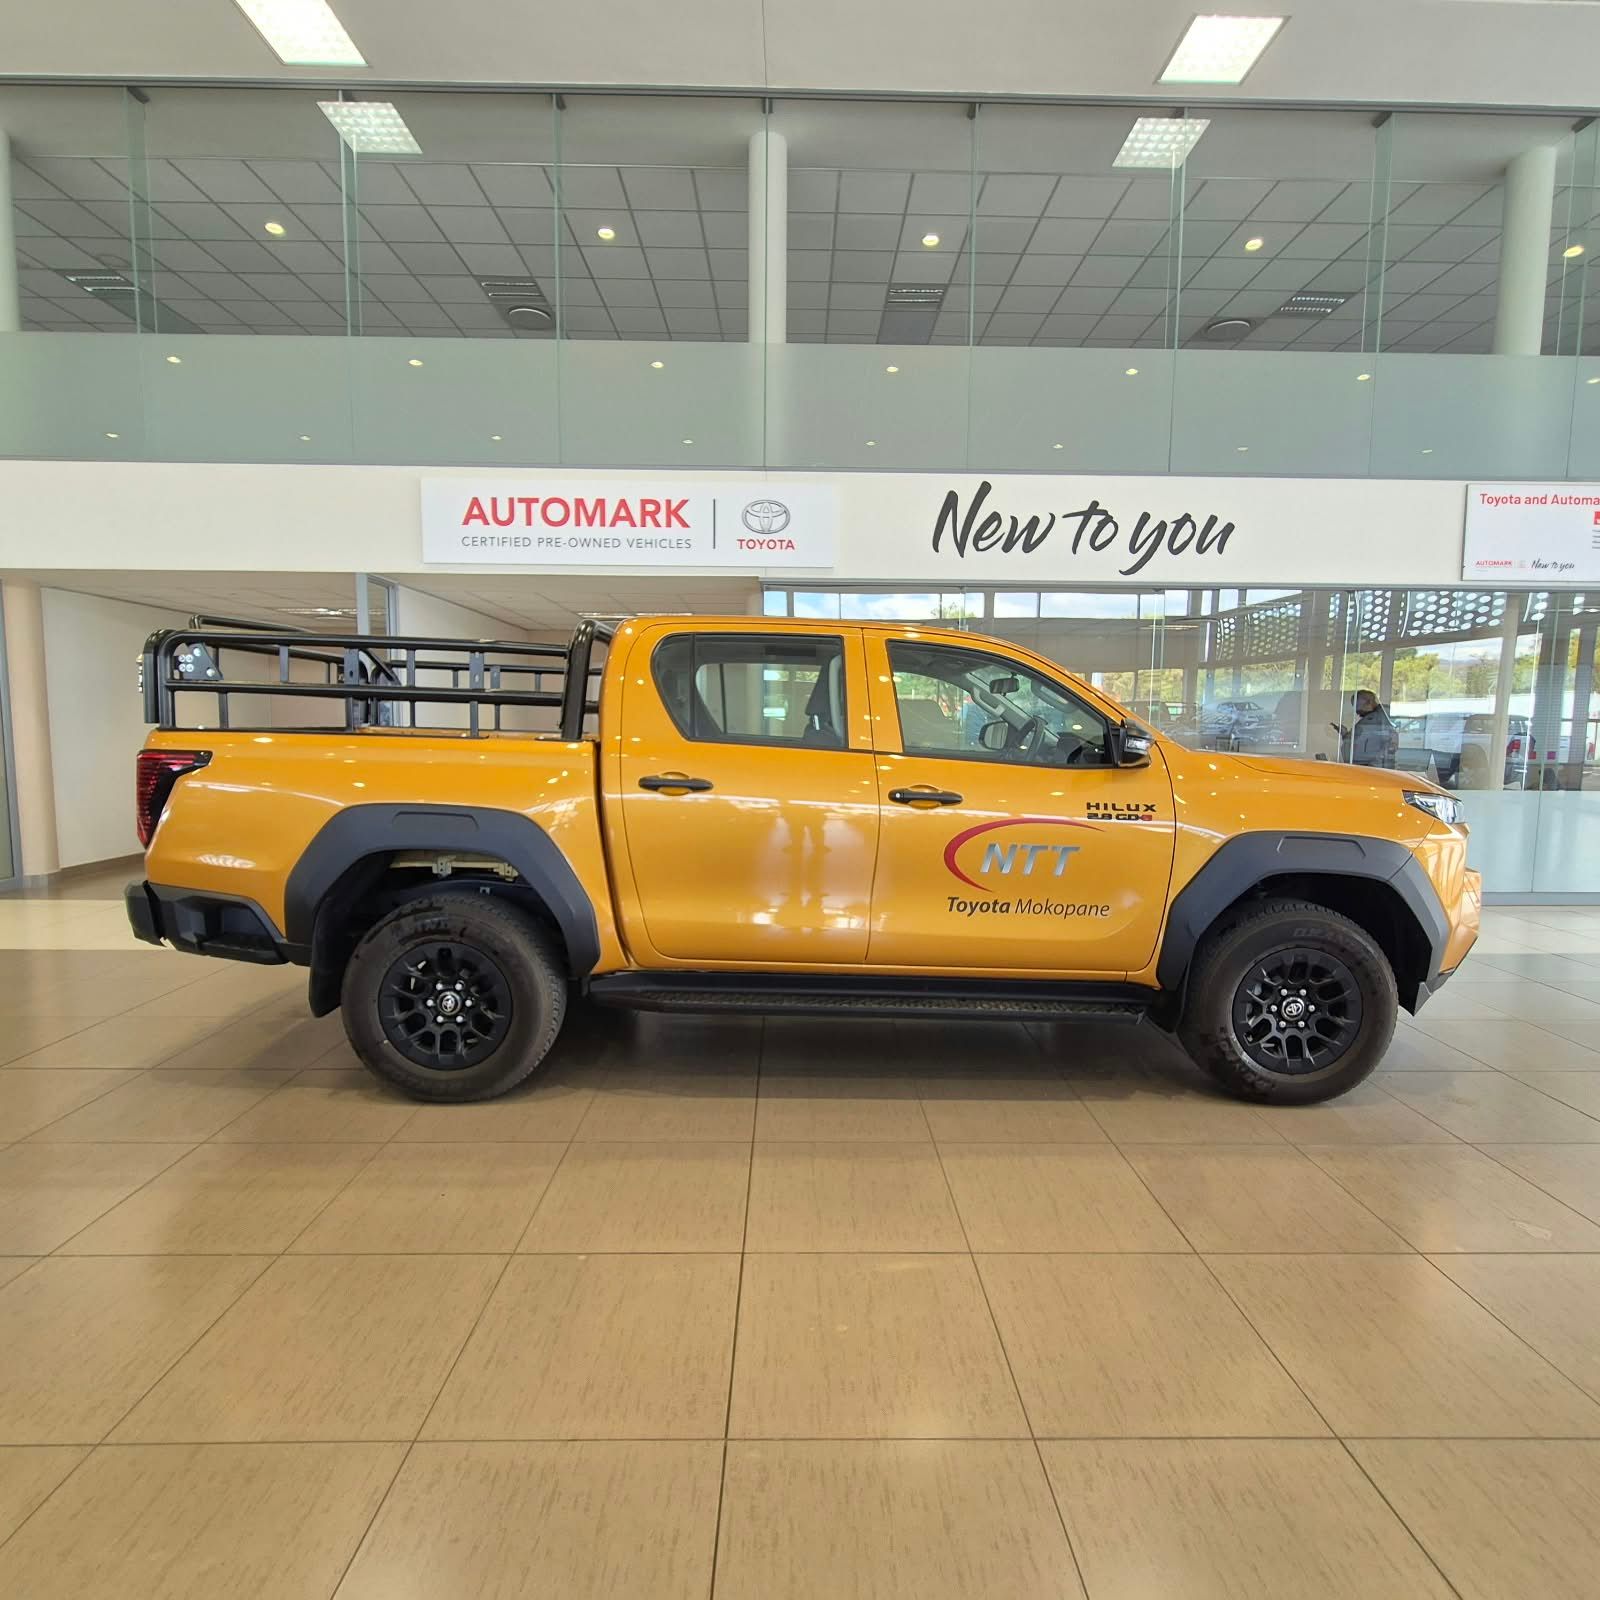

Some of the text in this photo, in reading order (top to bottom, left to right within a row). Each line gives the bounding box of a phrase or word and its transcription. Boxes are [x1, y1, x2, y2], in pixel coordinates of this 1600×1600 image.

[1480, 493, 1521, 507] Toyota
[1524, 494, 1548, 505] and
[462, 496, 690, 529] AUTOMARK
[932, 480, 1236, 576] New to you
[461, 536, 692, 549] CERTIFIED PRE-OWNED VEHICLES
[736, 538, 796, 551] TOYOTA
[1086, 802, 1157, 812] HILUX
[980, 842, 1081, 877] NTT
[947, 896, 1110, 919] Toyota Mokopane
